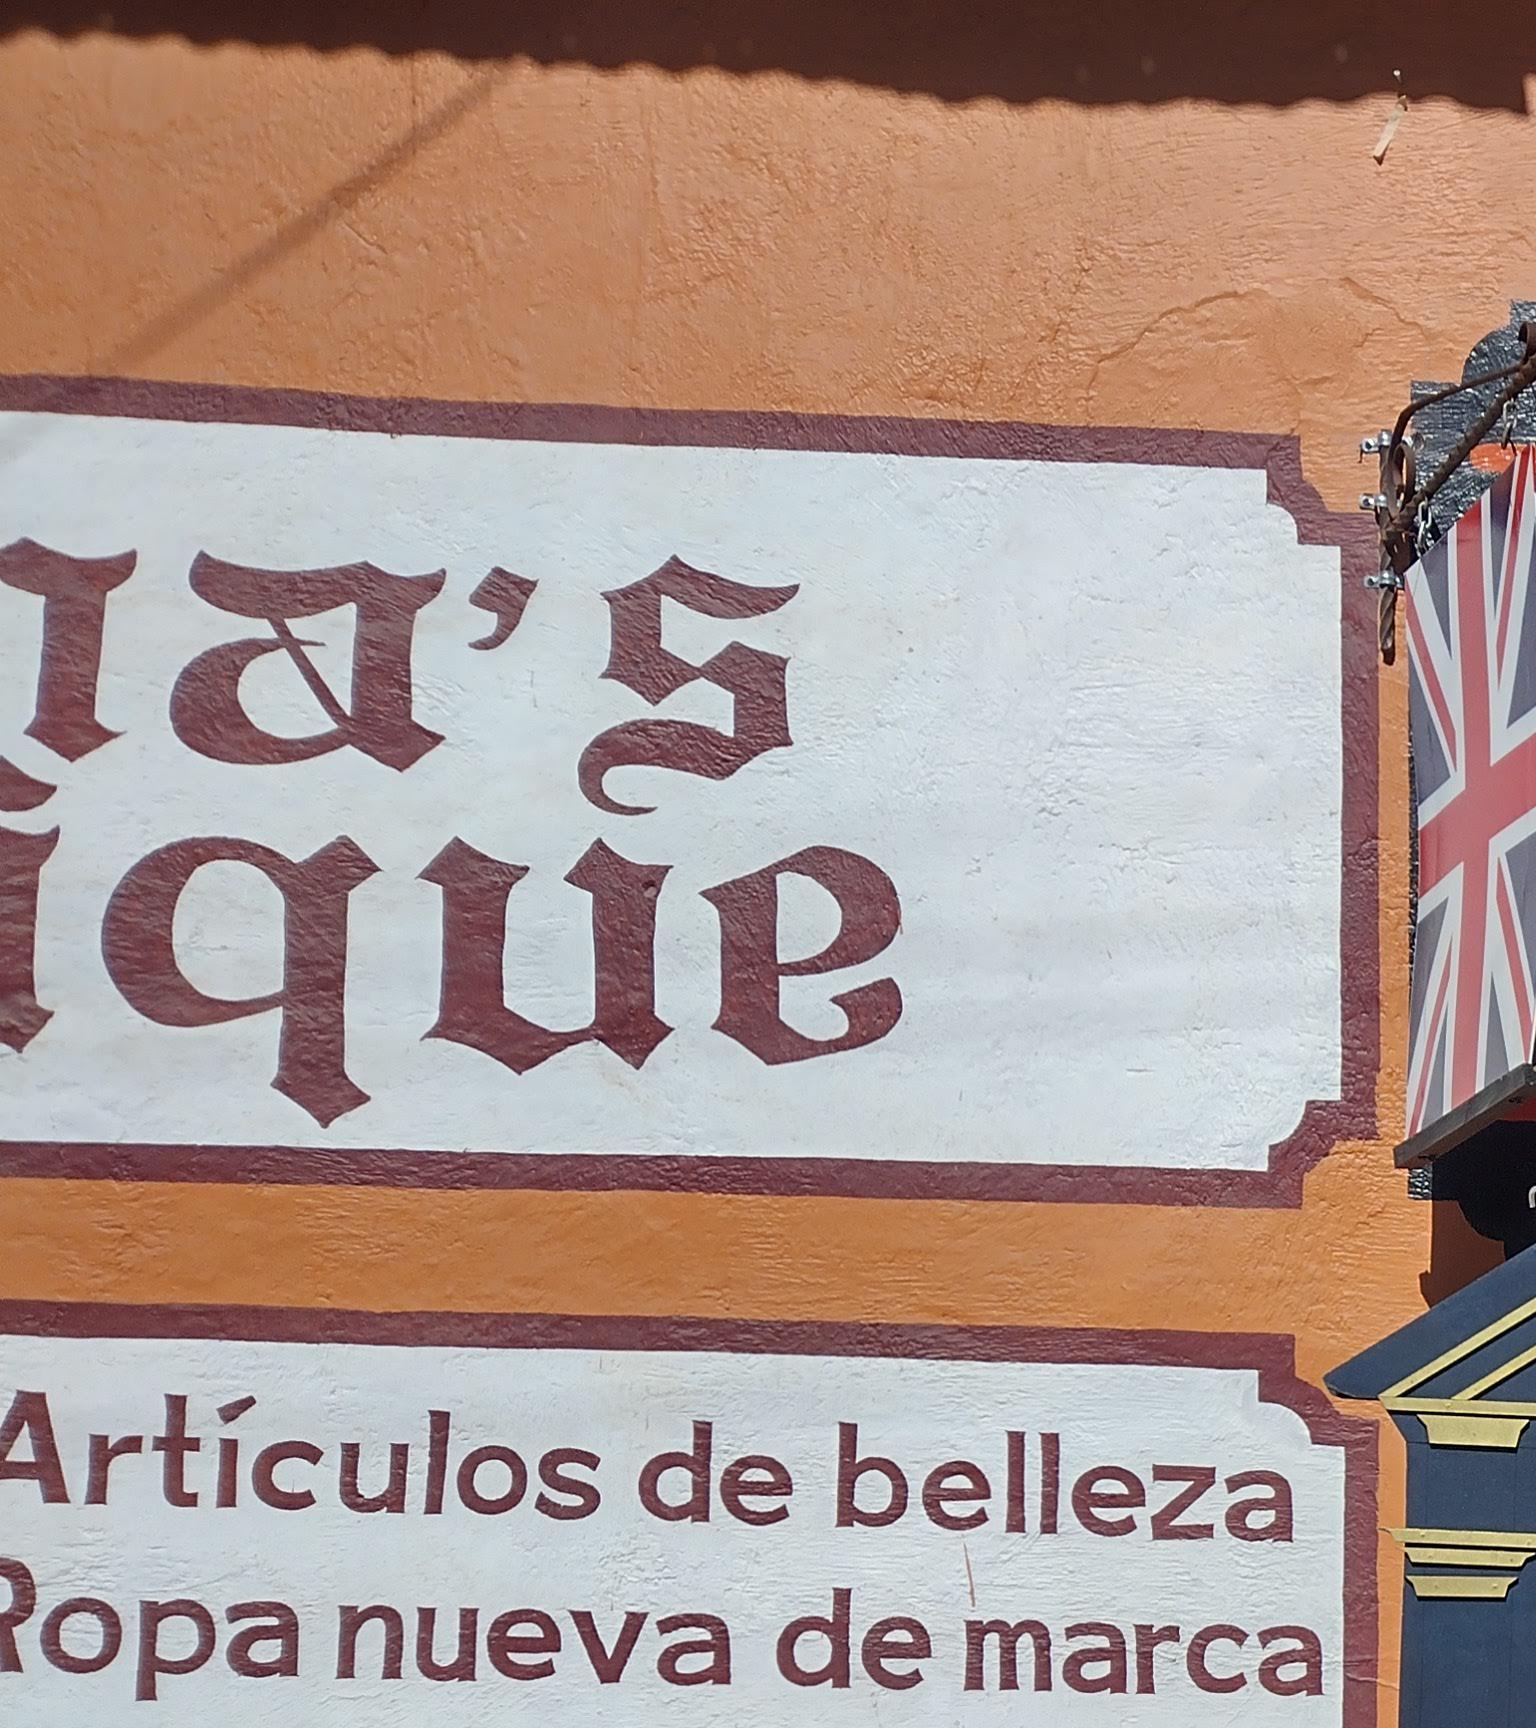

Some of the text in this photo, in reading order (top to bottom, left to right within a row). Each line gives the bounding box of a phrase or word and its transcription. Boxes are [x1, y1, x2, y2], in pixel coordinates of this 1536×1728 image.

[0, 1389, 1295, 1543] Artículos de belleza
[335, 1597, 732, 1686] nueva
[774, 1587, 933, 1692] de
[962, 1612, 1326, 1698] marca
